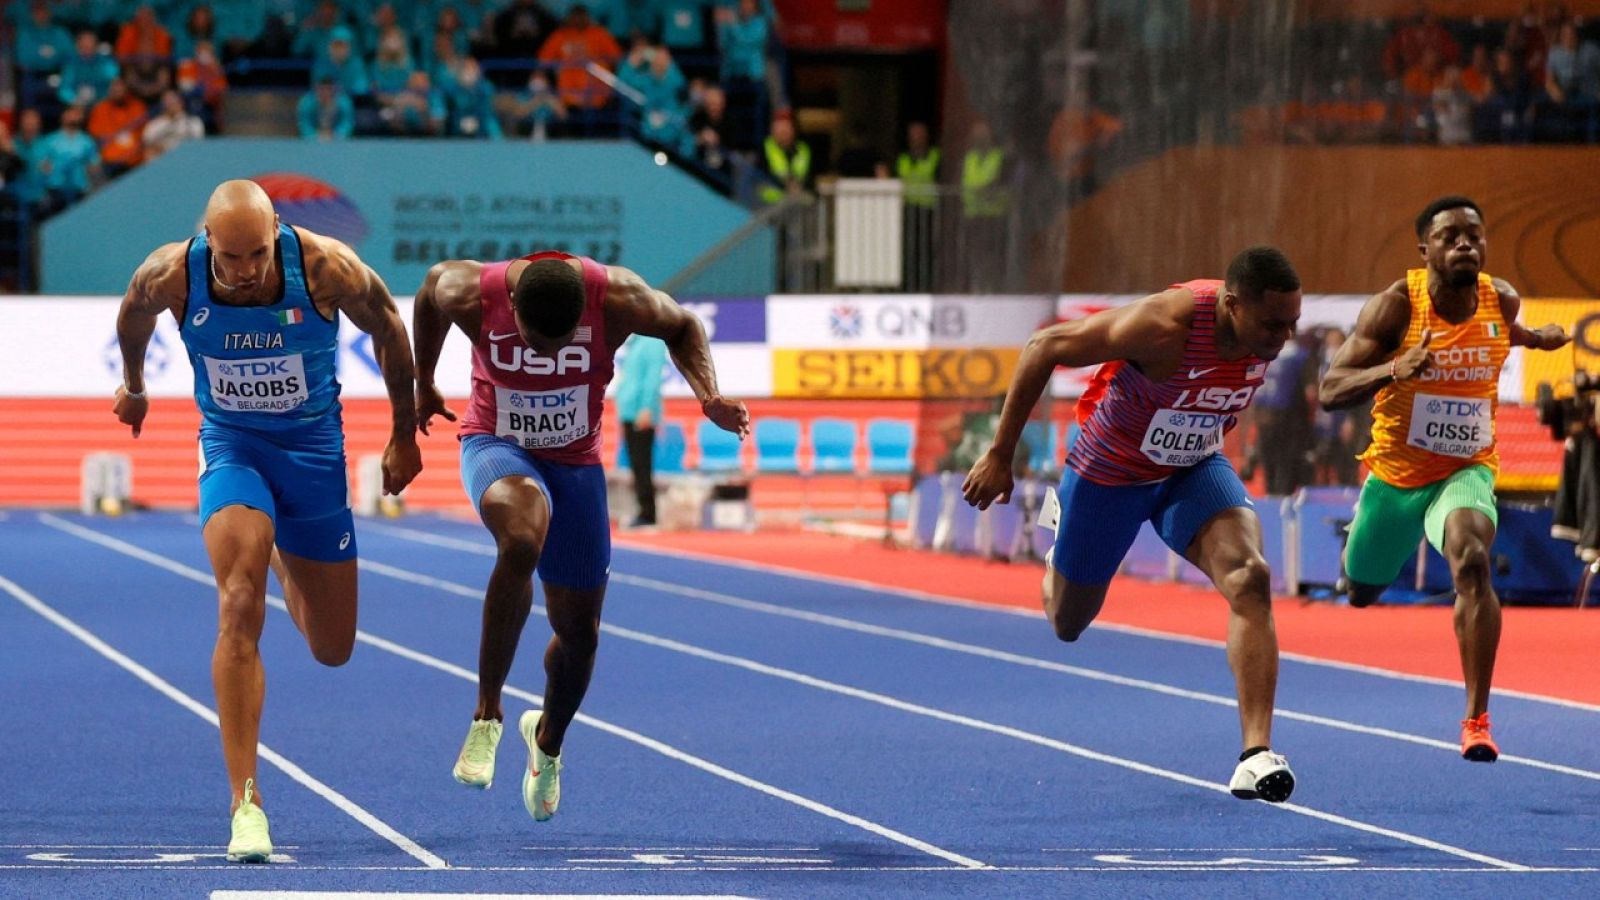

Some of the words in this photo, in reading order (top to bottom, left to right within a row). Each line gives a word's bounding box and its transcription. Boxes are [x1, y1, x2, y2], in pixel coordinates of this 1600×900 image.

[875, 304, 967, 338] QNB
[224, 332, 284, 350] ITALIA
[233, 360, 289, 377] TDK
[490, 343, 591, 376] USA
[798, 350, 999, 393] SEIKO
[215, 376, 300, 398] JACOBS
[237, 400, 290, 410] BELGRADE
[523, 390, 577, 409] TDK
[1171, 386, 1255, 411] USA
[1442, 400, 1483, 417] TDK
[509, 407, 578, 433] BRACY
[524, 431, 574, 448] BELGRADE
[575, 425, 586, 437] 22
[1426, 421, 1481, 442] CISSÉ
